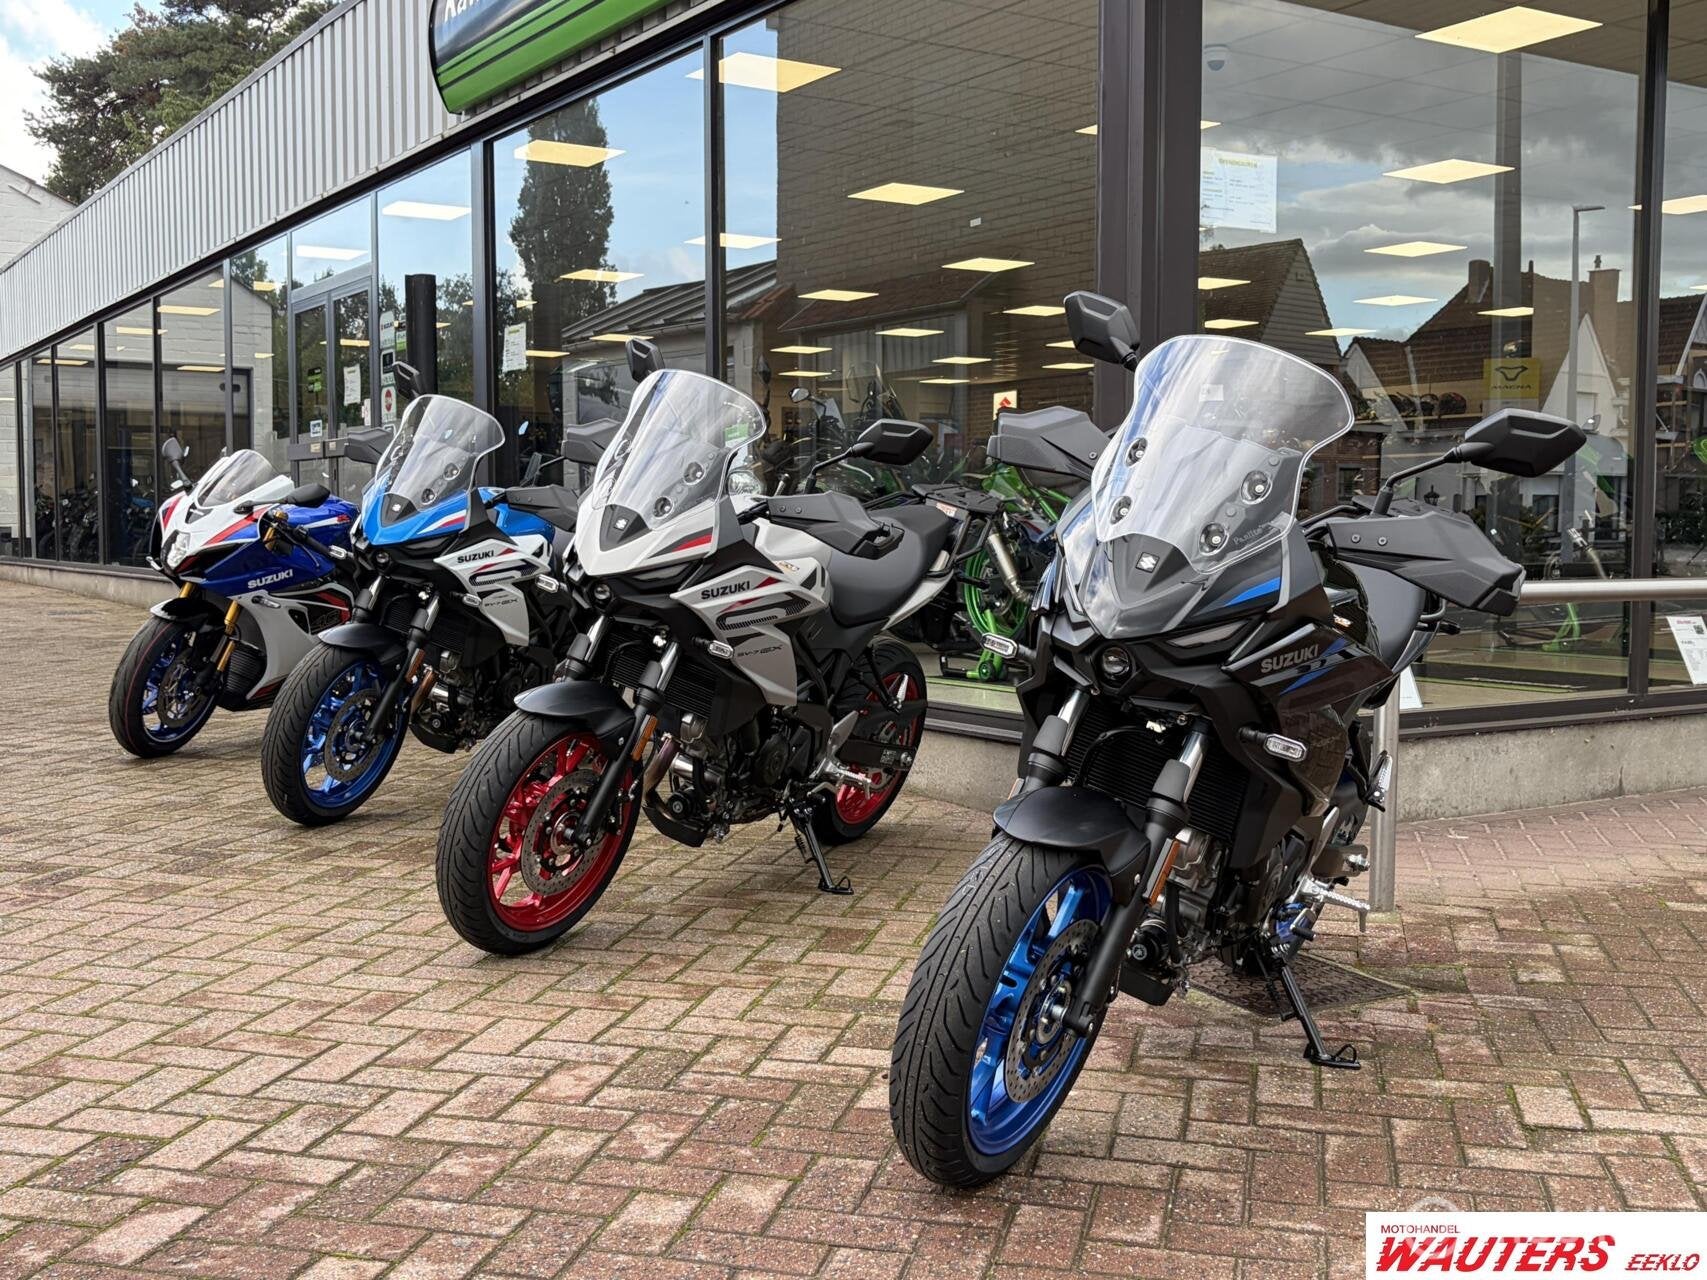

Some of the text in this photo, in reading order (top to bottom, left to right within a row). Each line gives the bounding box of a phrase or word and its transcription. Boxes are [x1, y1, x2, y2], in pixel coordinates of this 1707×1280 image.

[457, 550, 494, 564] SUZUKI
[247, 569, 293, 589] SUZUKI
[701, 581, 750, 600] SUZUKI
[1260, 643, 1319, 673] SUZUKI
